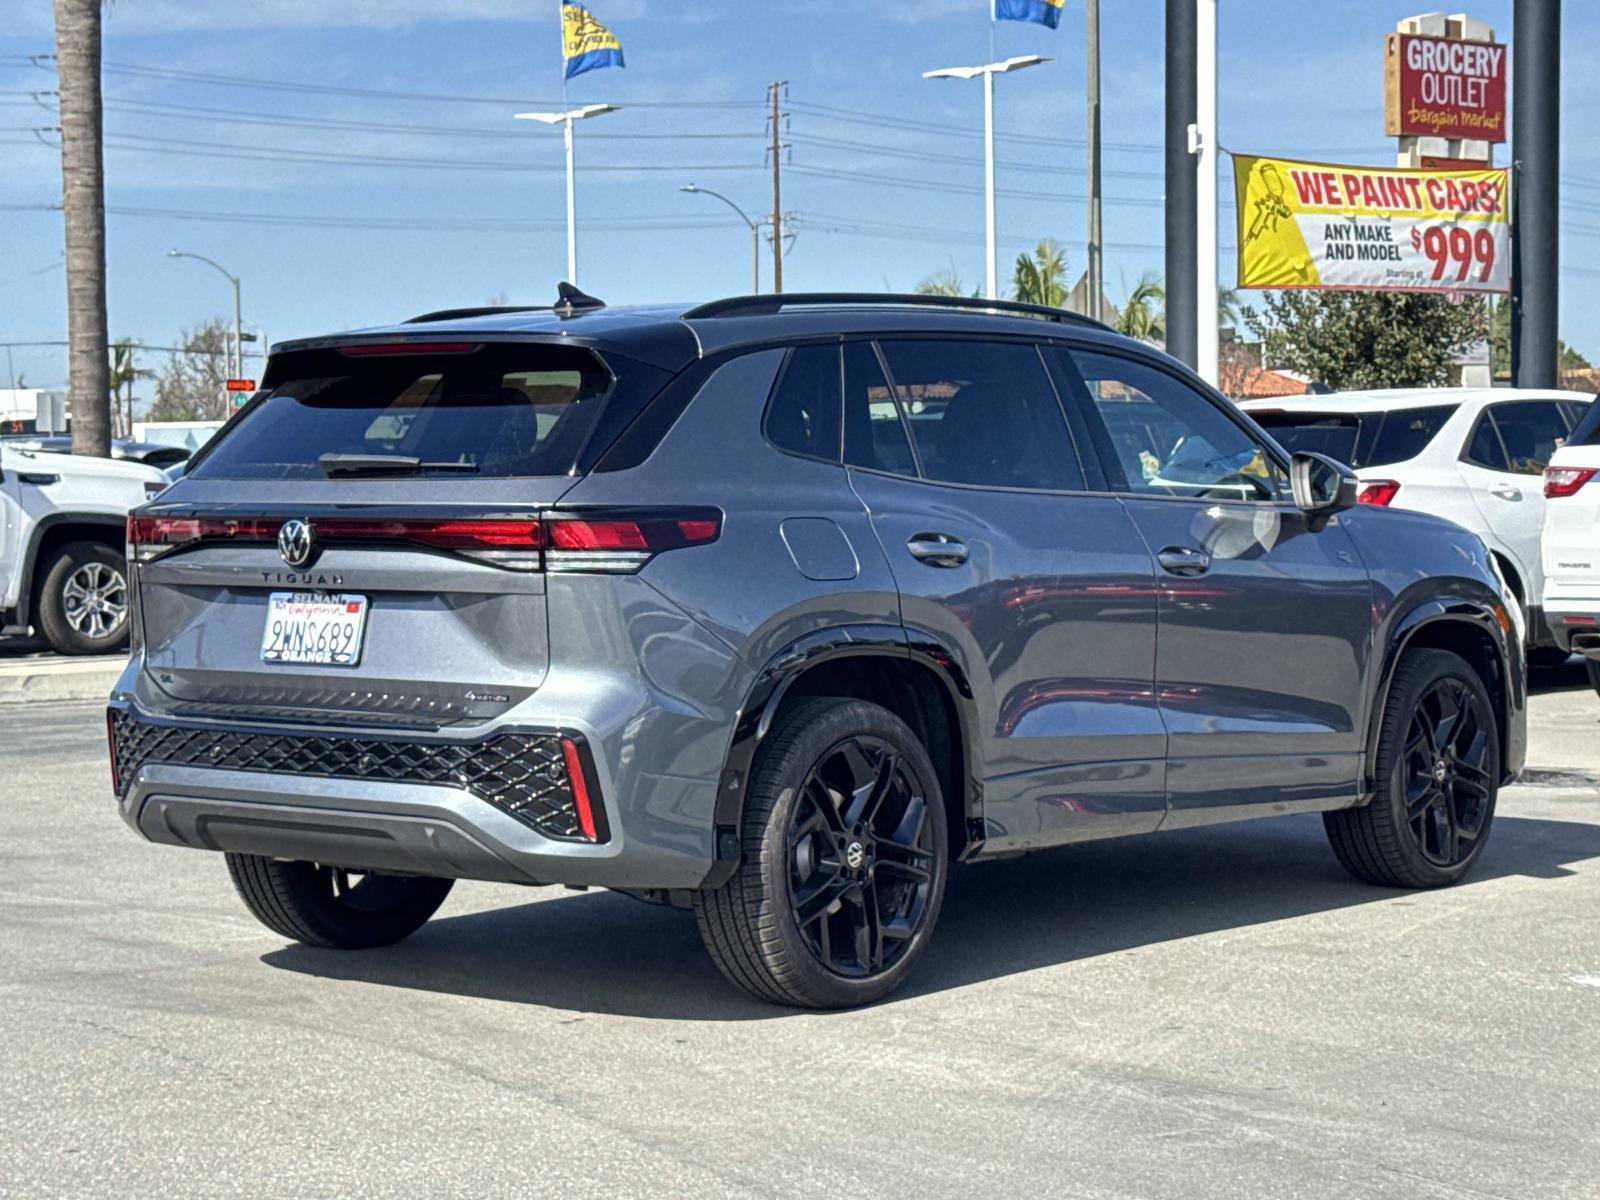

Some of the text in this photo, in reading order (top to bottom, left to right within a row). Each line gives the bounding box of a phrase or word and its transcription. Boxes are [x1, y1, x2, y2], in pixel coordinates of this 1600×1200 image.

[1407, 39, 1502, 78] GROCERY
[1421, 72, 1489, 108] OUTLET
[1408, 97, 1502, 133] bargain market
[1291, 171, 1501, 214] WE PAINT CARS!
[1324, 223, 1393, 242] ANY MAKE
[1325, 243, 1402, 261] AND MODEL
[1410, 225, 1495, 283] $999
[1386, 268, 1424, 280] Starting at
[262, 572, 344, 585] TIGUAN
[270, 619, 354, 654] 9WNS689
[281, 649, 332, 663] ORANGE
